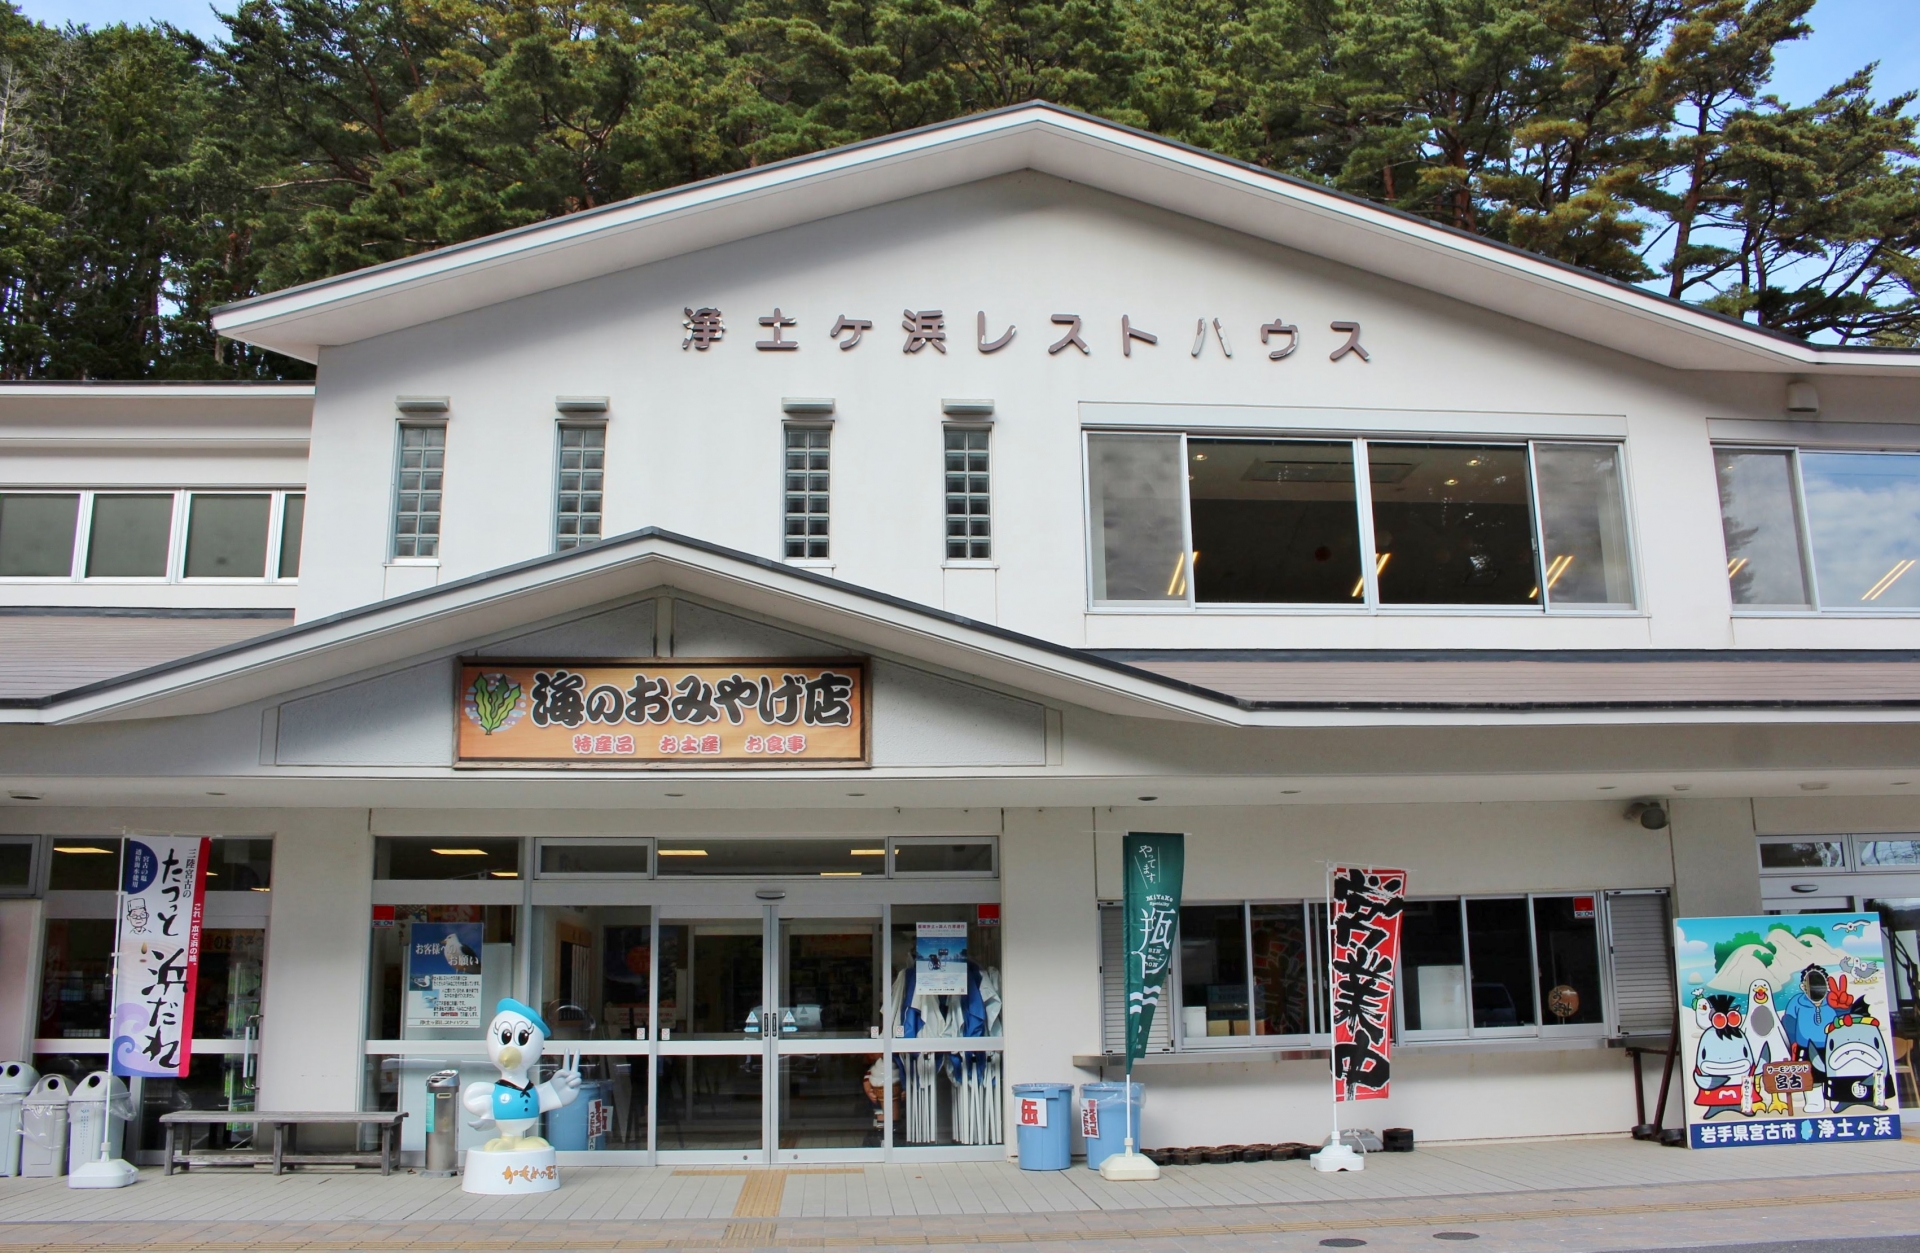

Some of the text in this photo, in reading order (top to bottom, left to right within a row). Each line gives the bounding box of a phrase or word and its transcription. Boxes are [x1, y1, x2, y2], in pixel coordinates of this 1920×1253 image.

[531, 670, 851, 728] 海のおみやげ店
[573, 734, 806, 754] 特産品 お土産 お食事
[182, 848, 197, 899] 三陸宮古の
[1331, 868, 1404, 1101] 営業中
[1776, 1074, 1802, 1089] 宮古
[1701, 1123, 1796, 1143] 岩手県宮古市
